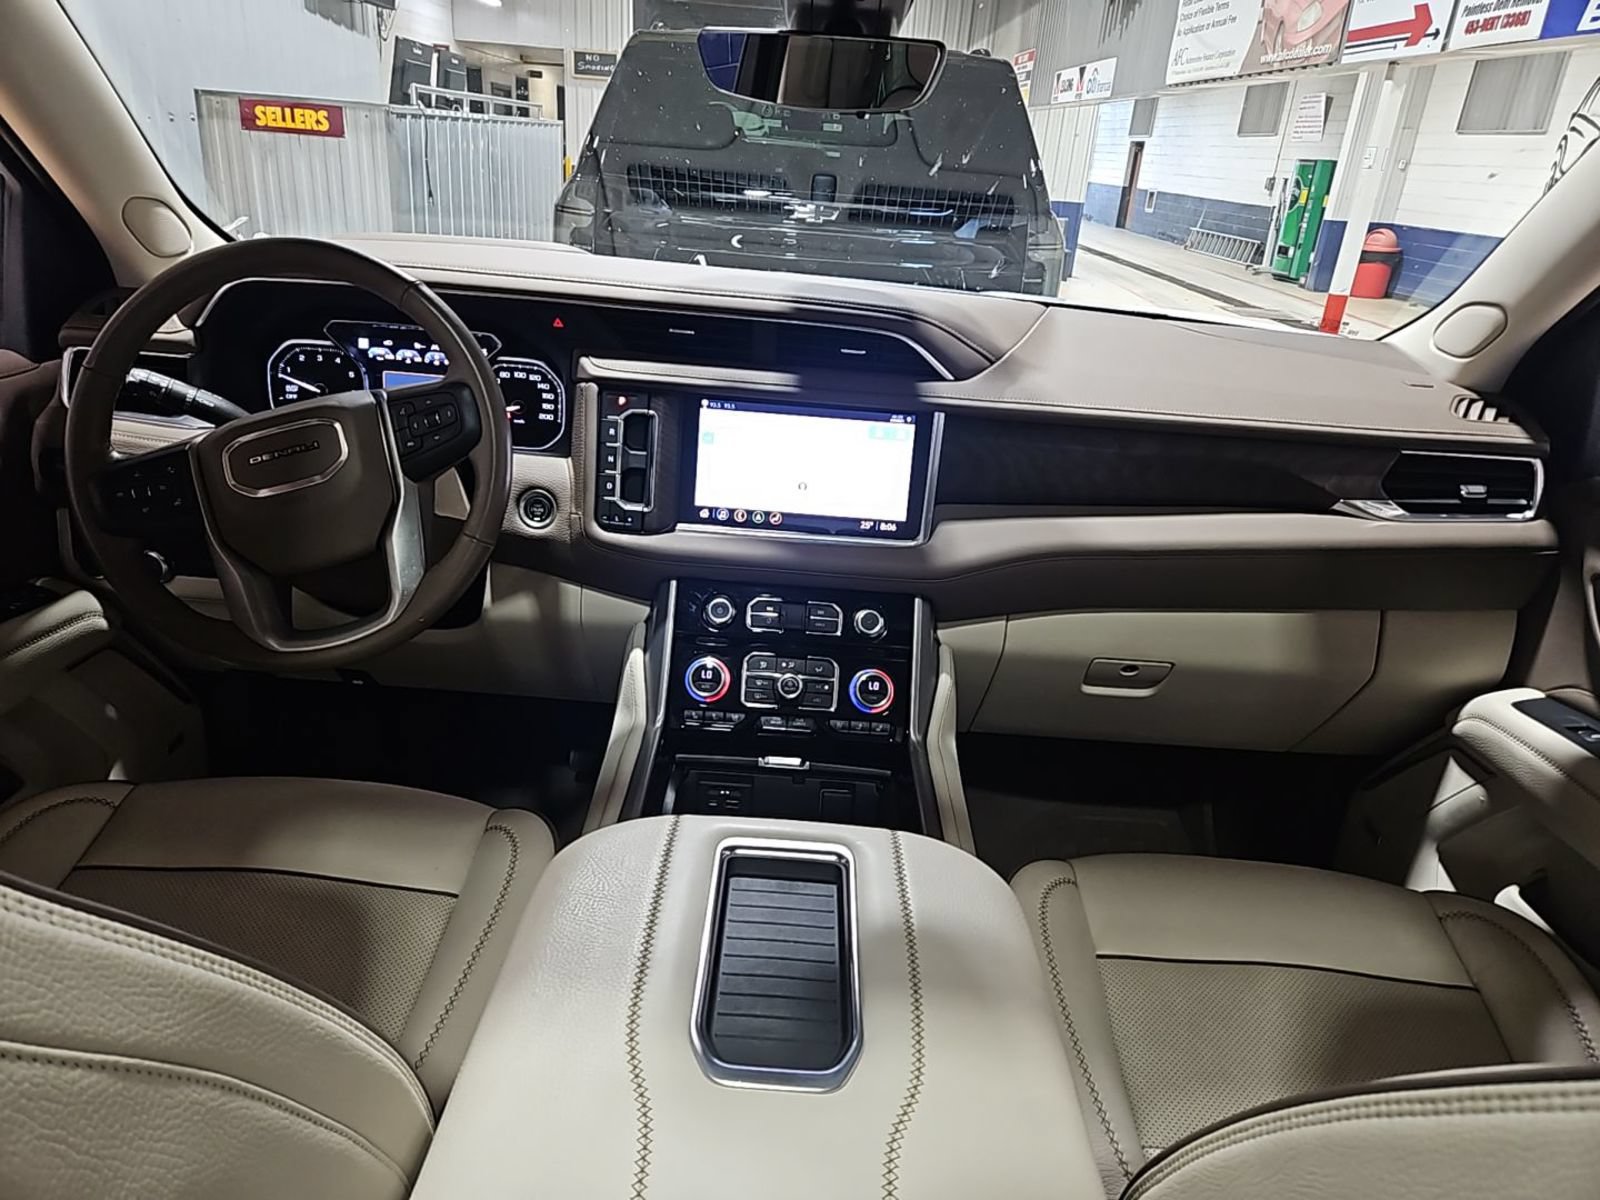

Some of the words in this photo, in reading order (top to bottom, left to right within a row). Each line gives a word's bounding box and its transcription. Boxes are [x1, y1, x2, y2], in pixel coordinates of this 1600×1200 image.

[1215, 1, 1230, 11] Terms
[1227, 14, 1238, 24] Fee
[585, 54, 600, 62] NO
[254, 105, 330, 132] SELLERS
[299, 354, 305, 362] 2
[317, 354, 323, 362] 3
[513, 371, 527, 379] 100
[528, 374, 542, 382] 120
[538, 413, 554, 421] 200
[608, 427, 616, 436] R
[249, 441, 319, 464] DENALI
[607, 454, 615, 463] N
[606, 481, 613, 490] D
[880, 521, 897, 532] 8:06
[701, 669, 713, 680] LO
[868, 681, 880, 691] LO
